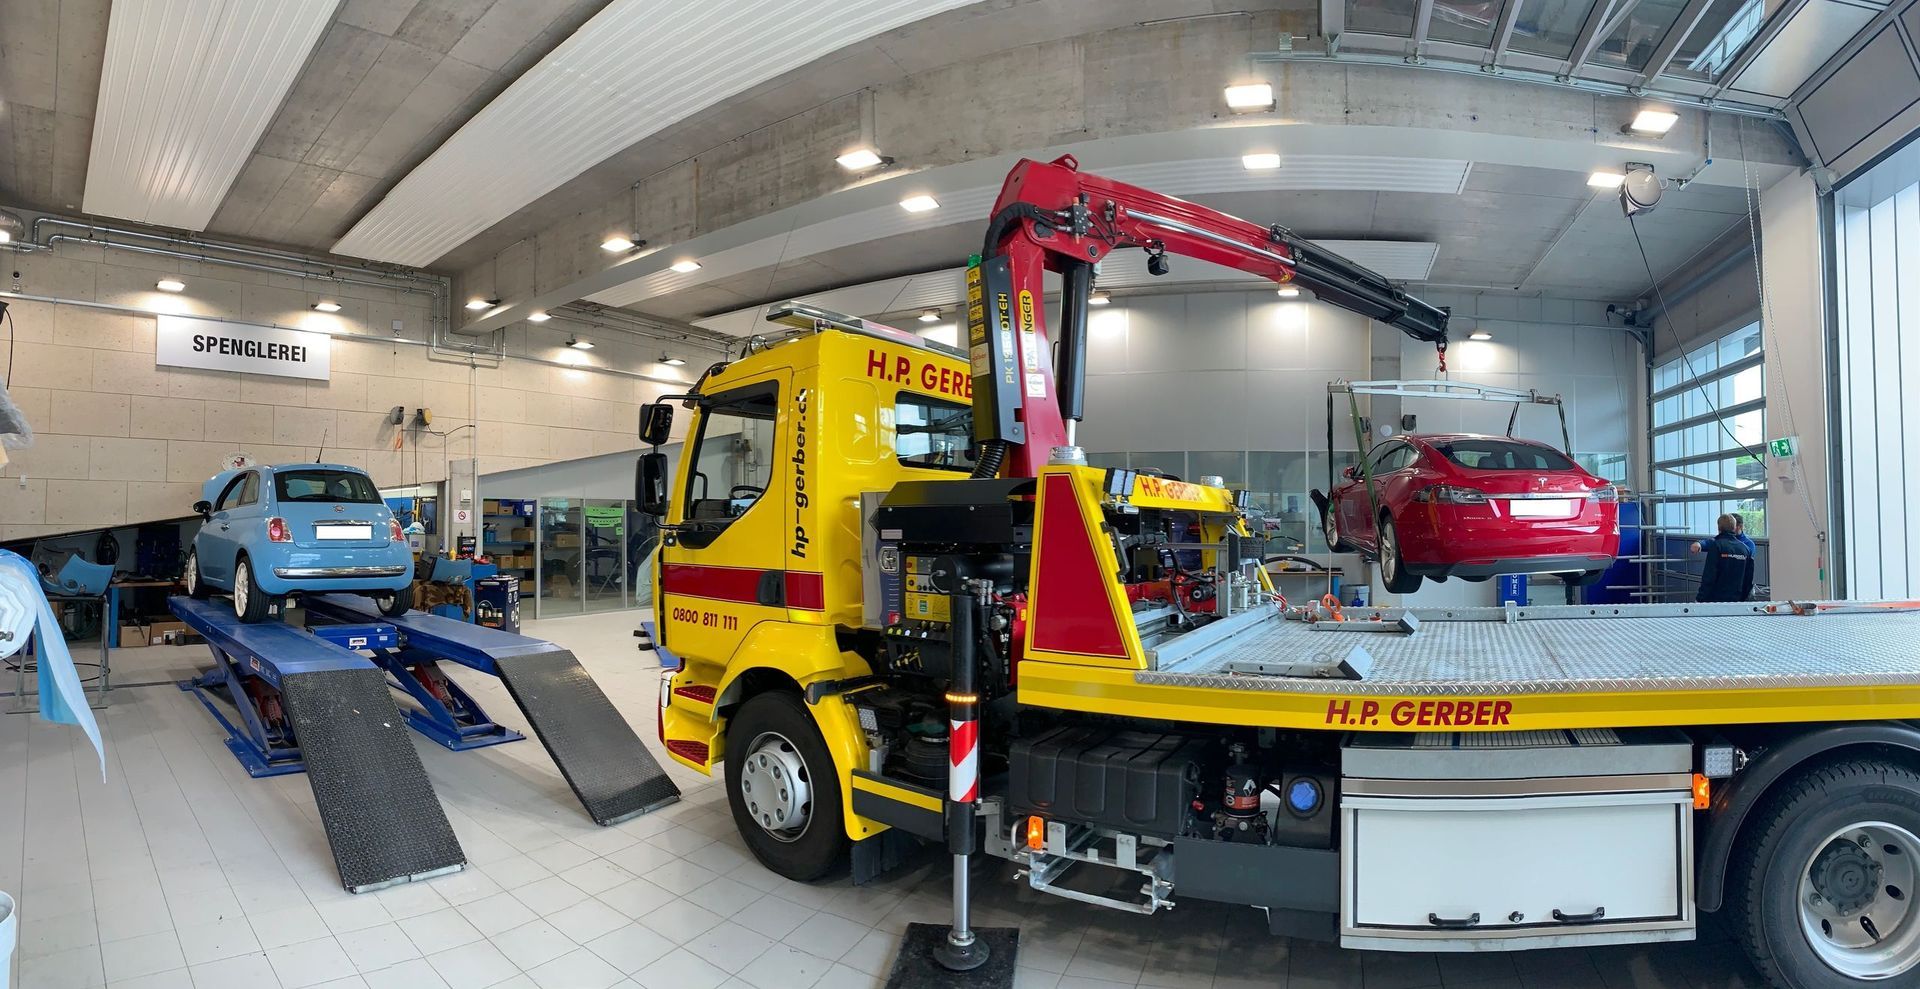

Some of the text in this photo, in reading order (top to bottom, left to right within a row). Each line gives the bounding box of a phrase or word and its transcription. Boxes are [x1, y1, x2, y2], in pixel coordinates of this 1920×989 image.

[193, 335, 307, 362] SPENGLEREI
[867, 349, 911, 386] H.P.
[1005, 366, 1015, 384] PK
[1140, 476, 1164, 498] H.P.
[673, 607, 738, 631] 0800 811 111
[1326, 700, 1512, 726] H.P. GERBER
